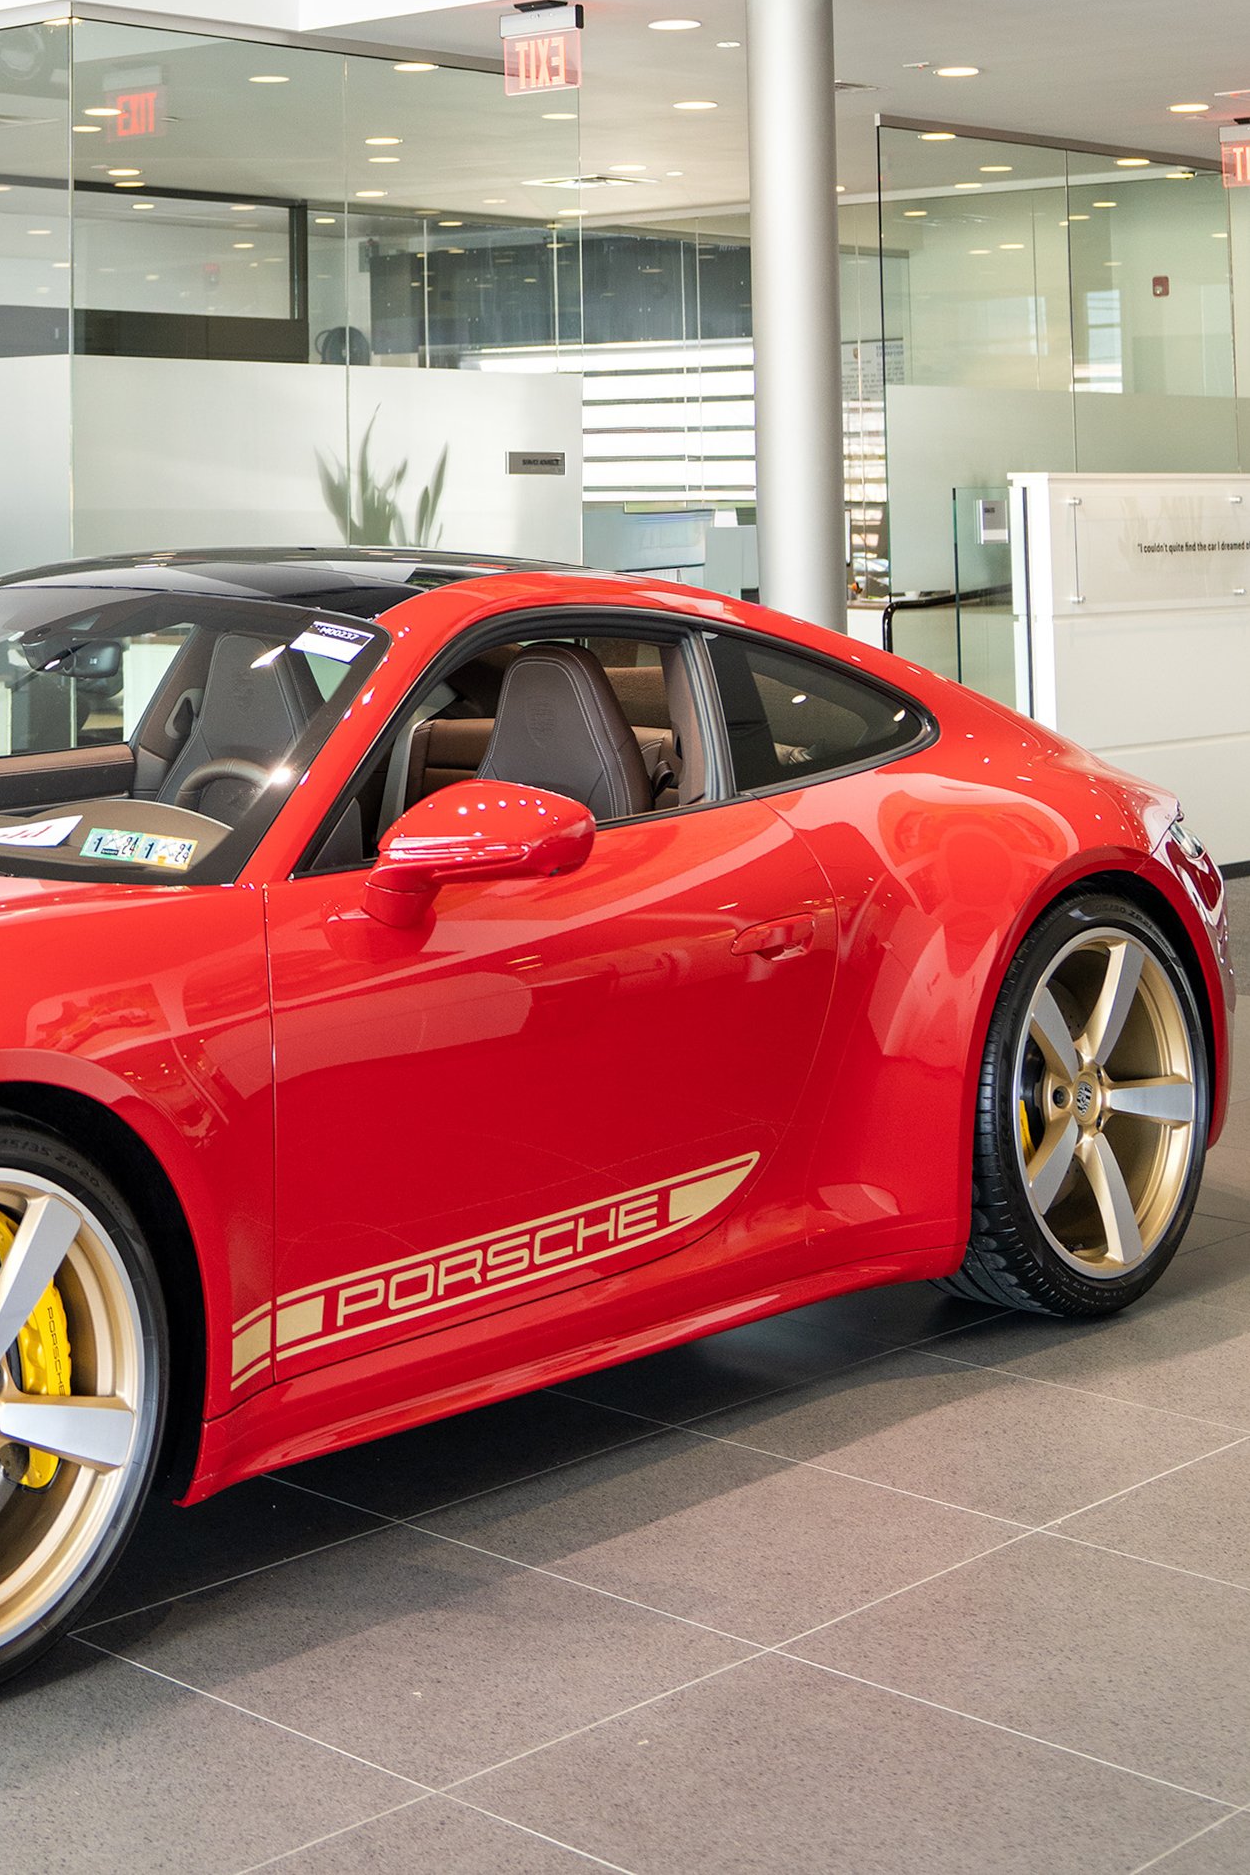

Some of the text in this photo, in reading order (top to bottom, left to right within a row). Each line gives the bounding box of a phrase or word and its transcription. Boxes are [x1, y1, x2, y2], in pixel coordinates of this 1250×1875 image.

[1168, 541, 1184, 555] quite
[1184, 541, 1196, 552] find
[1196, 541, 1207, 552] the
[1207, 543, 1217, 552] car
[1220, 540, 1245, 551] dreamed
[336, 1193, 659, 1327] PORSCHE
